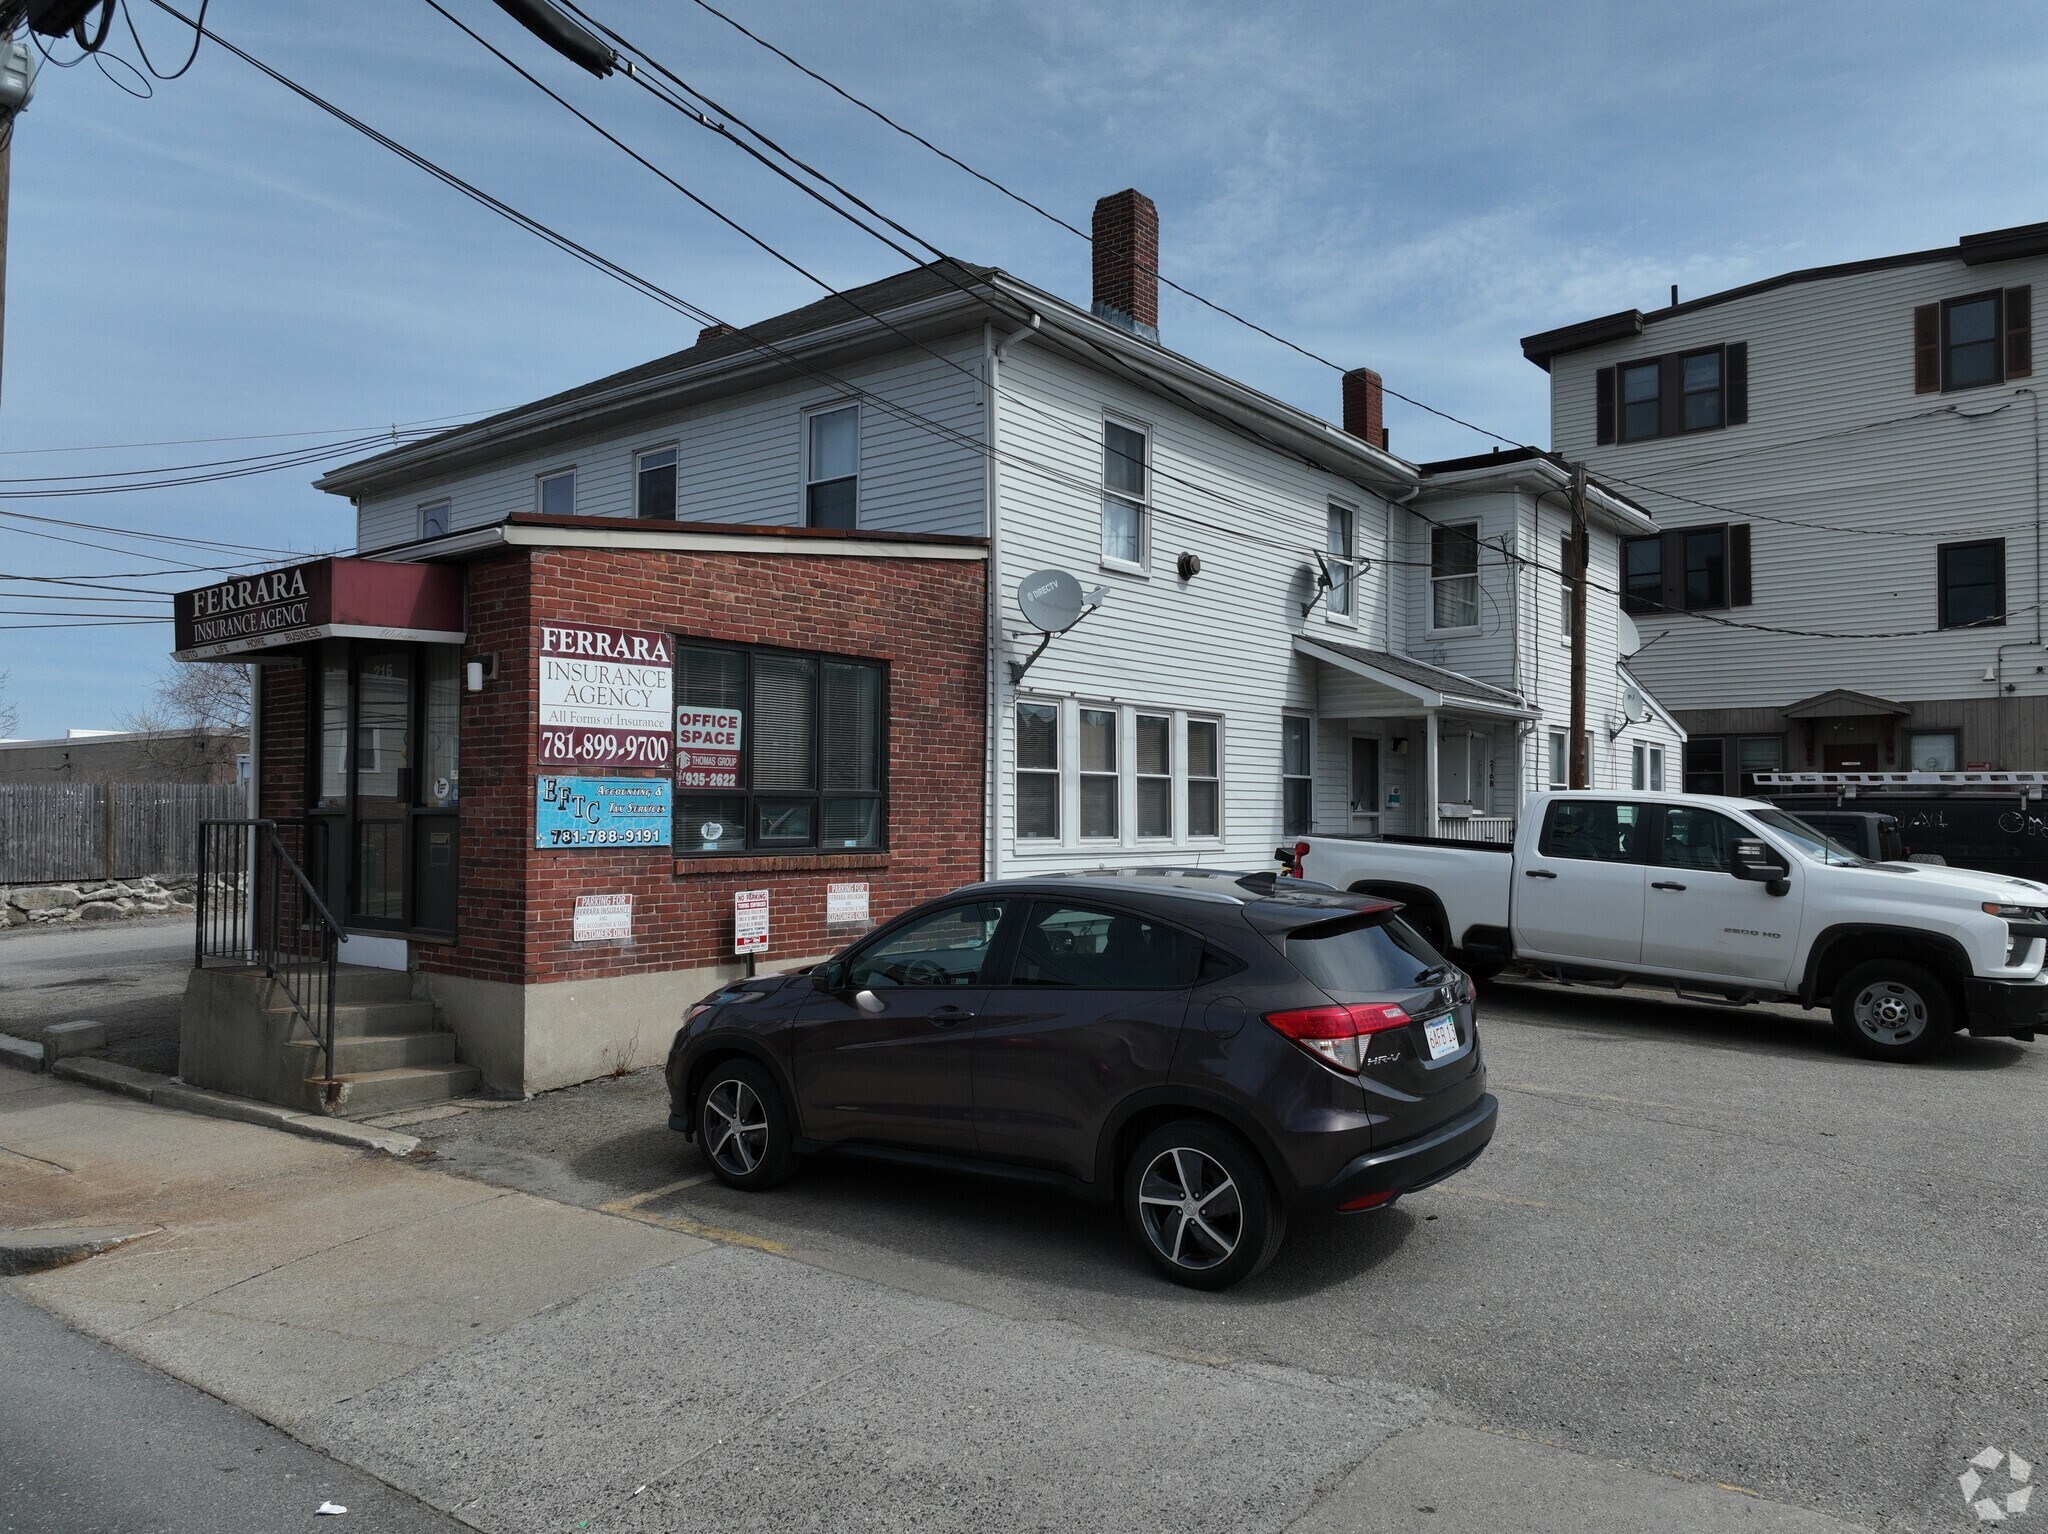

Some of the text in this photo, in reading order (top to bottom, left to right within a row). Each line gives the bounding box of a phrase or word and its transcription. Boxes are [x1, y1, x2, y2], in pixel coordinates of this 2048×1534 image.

[192, 568, 307, 617] FERRARA
[1032, 580, 1059, 599] DIRECTV
[194, 602, 309, 642] INSURANCE AGENCY
[180, 627, 322, 661] AUTO LIFE HOME BUSINESS
[540, 627, 670, 662] FERRARA
[374, 664, 393, 678] 216
[547, 661, 667, 689] INSURANCE
[563, 684, 653, 708] AGENCY
[549, 710, 665, 728] All Forms of Insurance
[679, 713, 738, 729] OFFICE
[680, 730, 735, 745] SPACE
[542, 731, 669, 762] 781-899-9700
[692, 755, 716, 766] THOMAS
[717, 756, 737, 767] GROUP
[654, 786, 663, 796] &
[543, 778, 600, 824] EFTC
[551, 828, 660, 844] 781-788-9191
[832, 883, 864, 892] PARKING FOR
[582, 895, 626, 907] PARKING FOR
[746, 893, 766, 901] PARKING
[576, 906, 629, 916] FERRARA INSURANCE
[576, 928, 629, 939] CUSTOMERS ONLY
[1723, 927, 1781, 939] 2500 HD
[1367, 1052, 1401, 1066] HR-V
